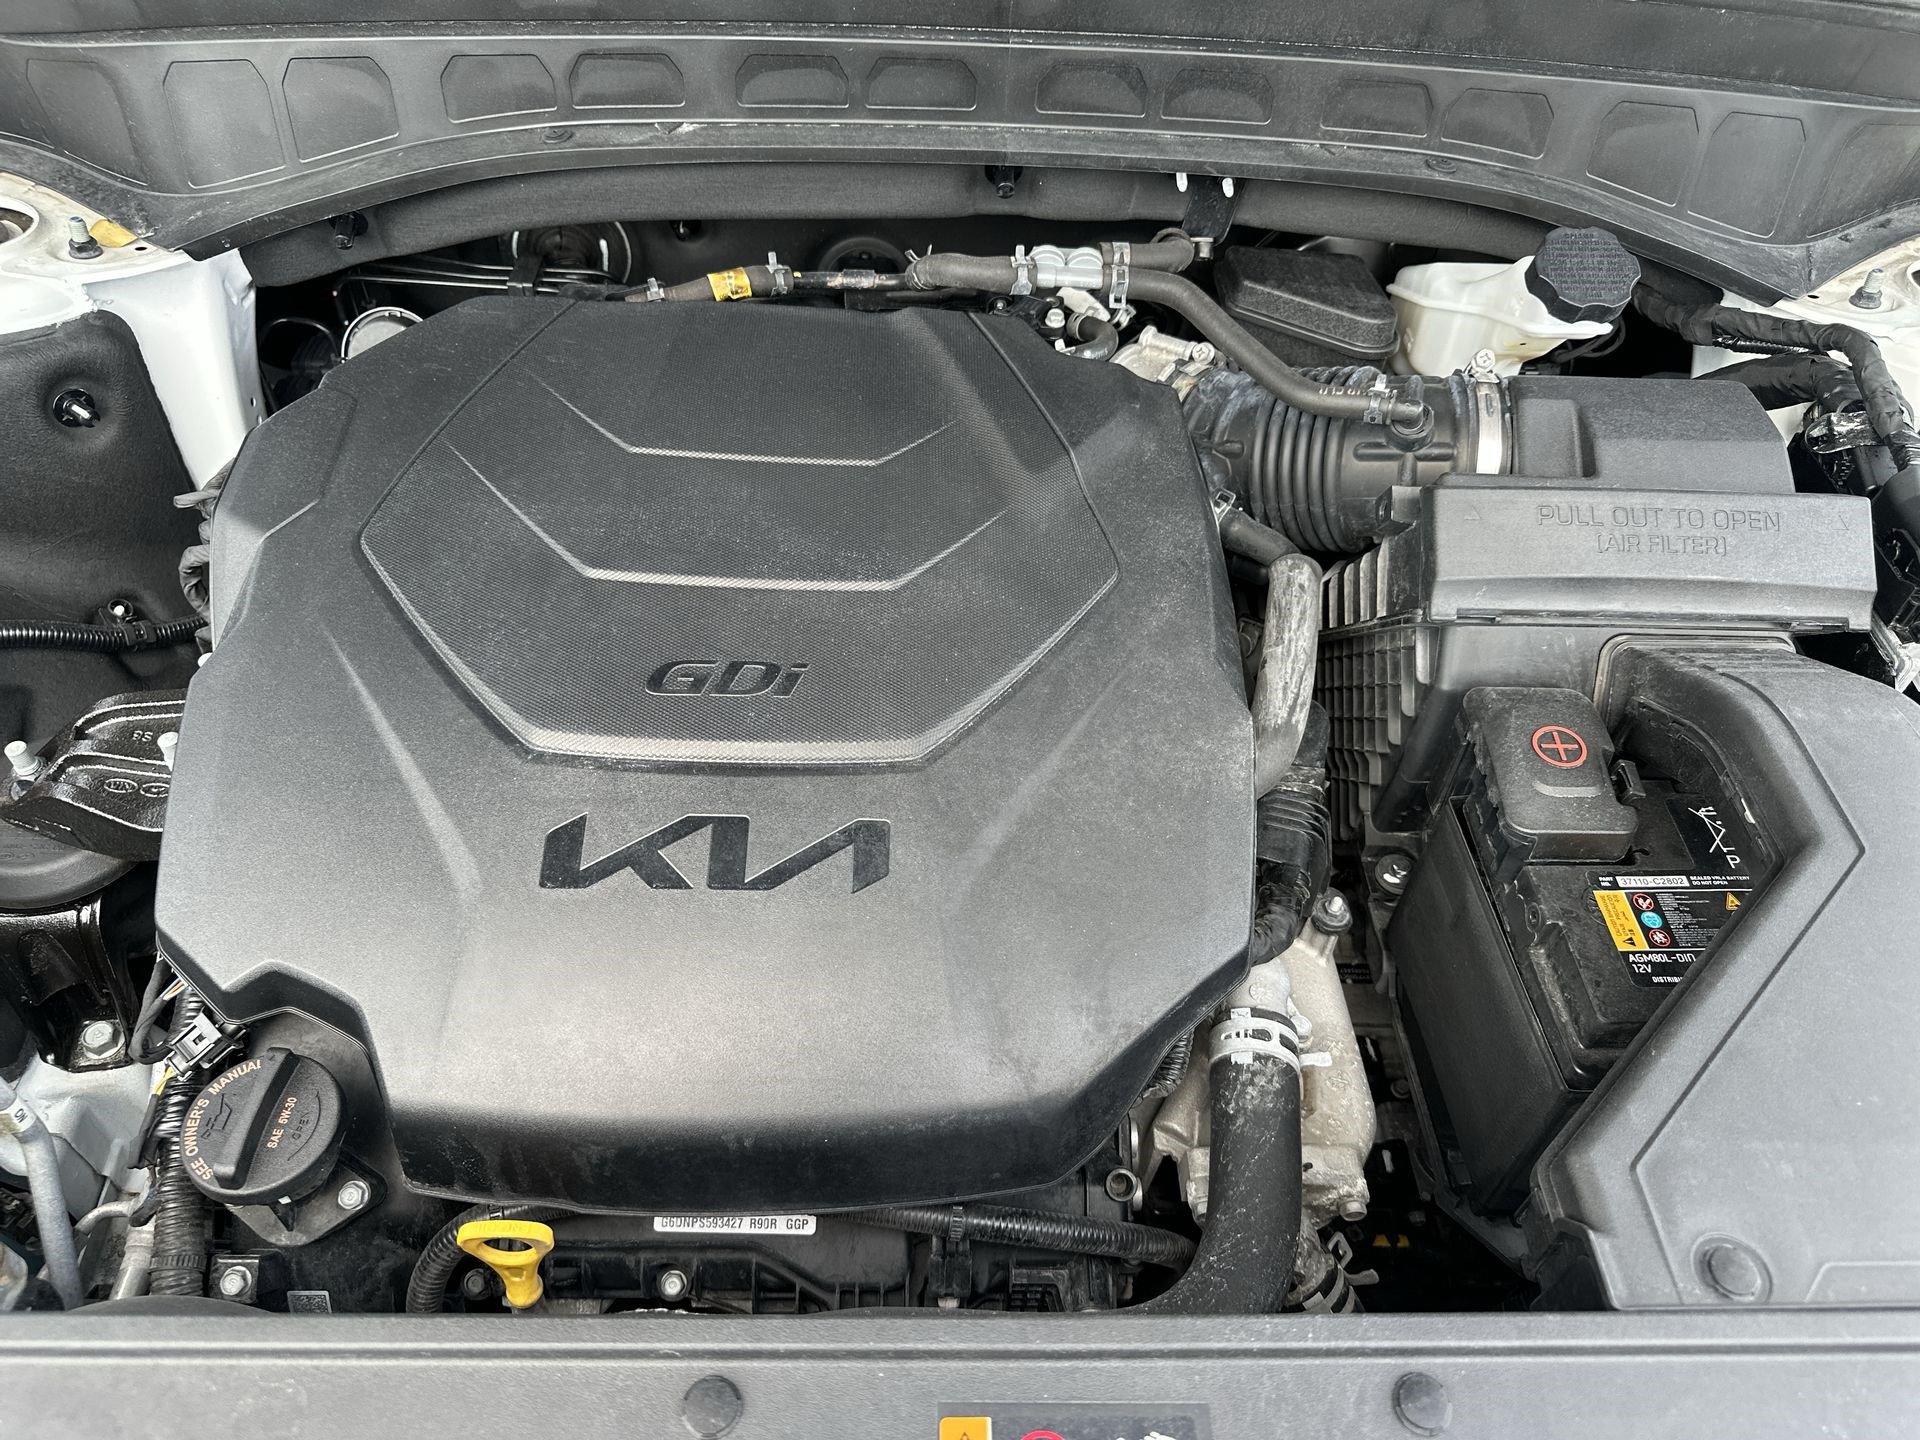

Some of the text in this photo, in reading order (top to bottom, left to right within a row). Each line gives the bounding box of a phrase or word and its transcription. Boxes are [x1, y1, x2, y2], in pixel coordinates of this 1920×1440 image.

[1537, 505, 1781, 531] PULL OUT TO OPEN
[645, 659, 811, 698] GDi
[539, 812, 891, 894] KIA
[1620, 877, 1685, 886] 37110-C2802
[1632, 963, 1652, 974] 12V
[184, 1059, 262, 1180] SEE OWNER'S MANUAL
[266, 1097, 298, 1149] SAE 5W-30
[786, 1219, 809, 1231] GGP
